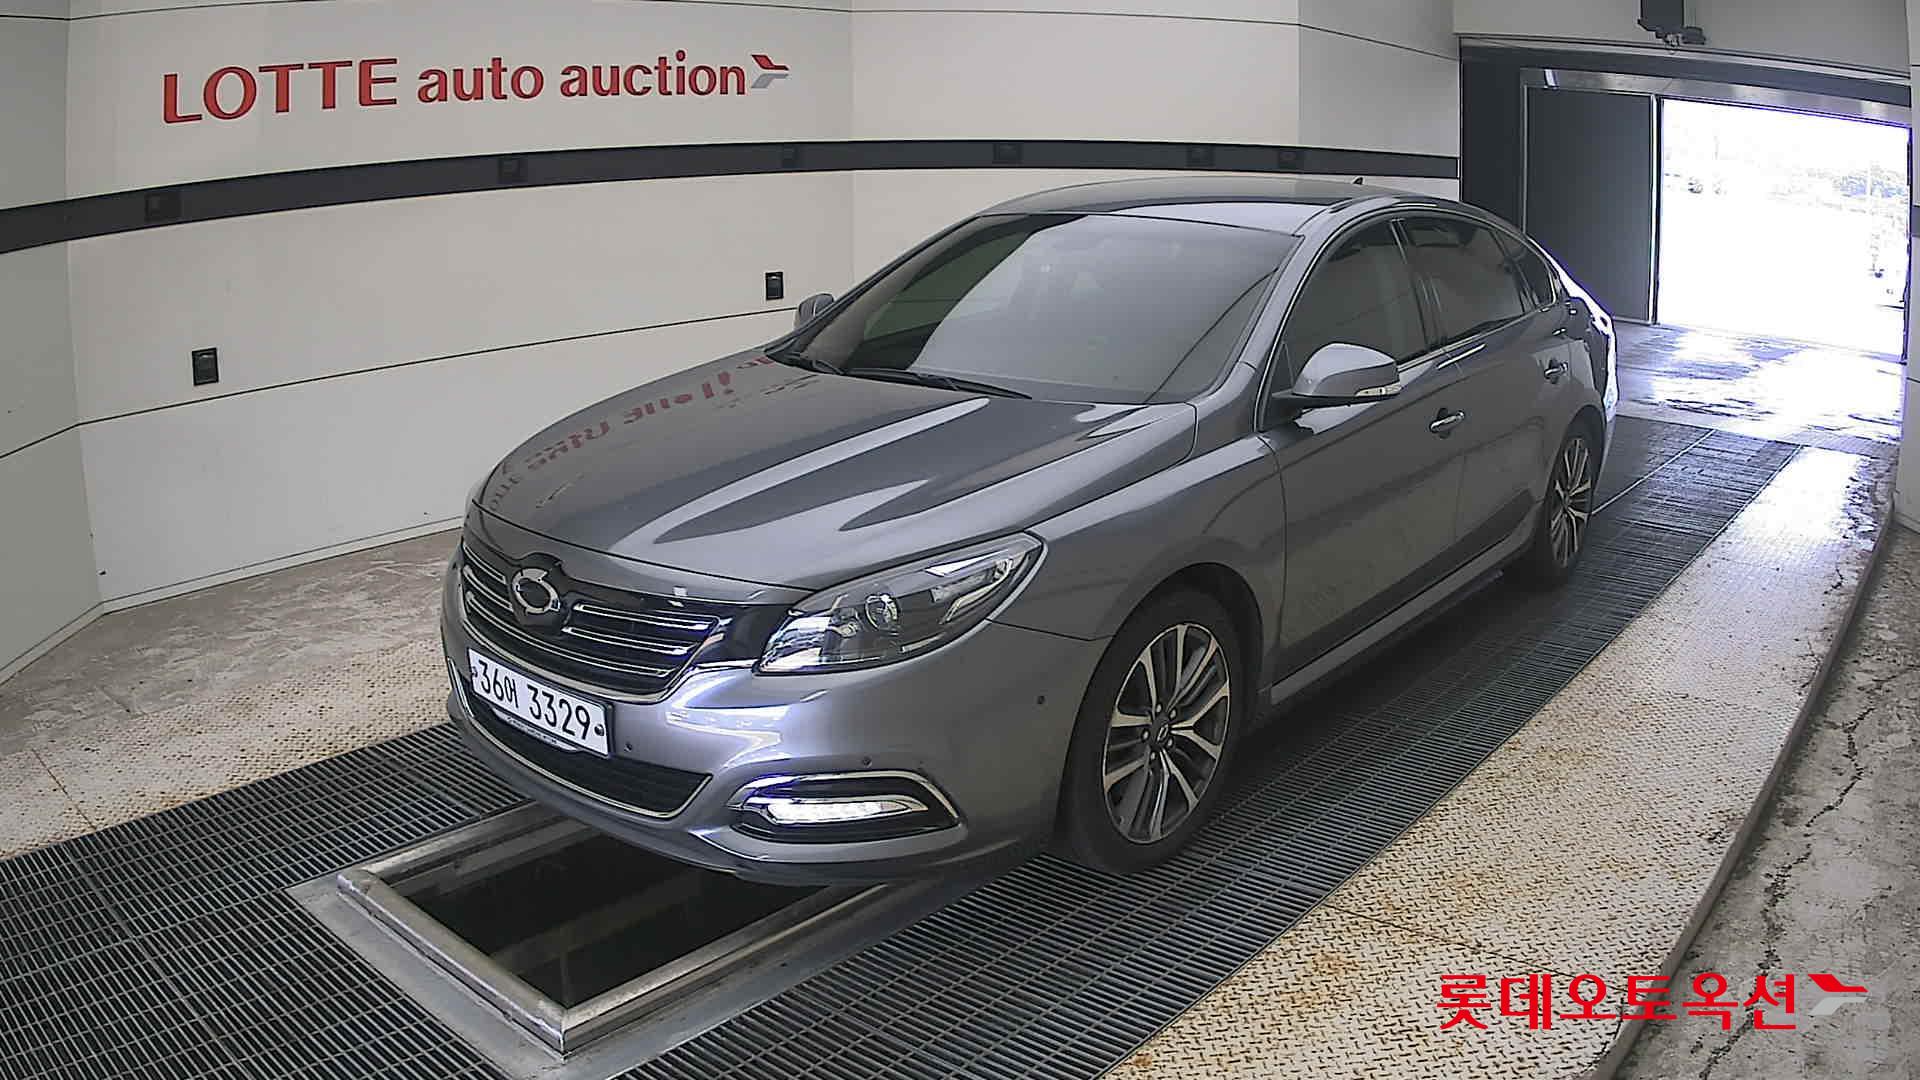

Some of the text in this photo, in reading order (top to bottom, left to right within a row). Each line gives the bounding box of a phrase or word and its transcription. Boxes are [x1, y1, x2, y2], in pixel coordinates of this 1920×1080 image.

[163, 51, 747, 124] LOTTE auto auction
[478, 660, 518, 709] 36어
[527, 684, 590, 740] 3329
